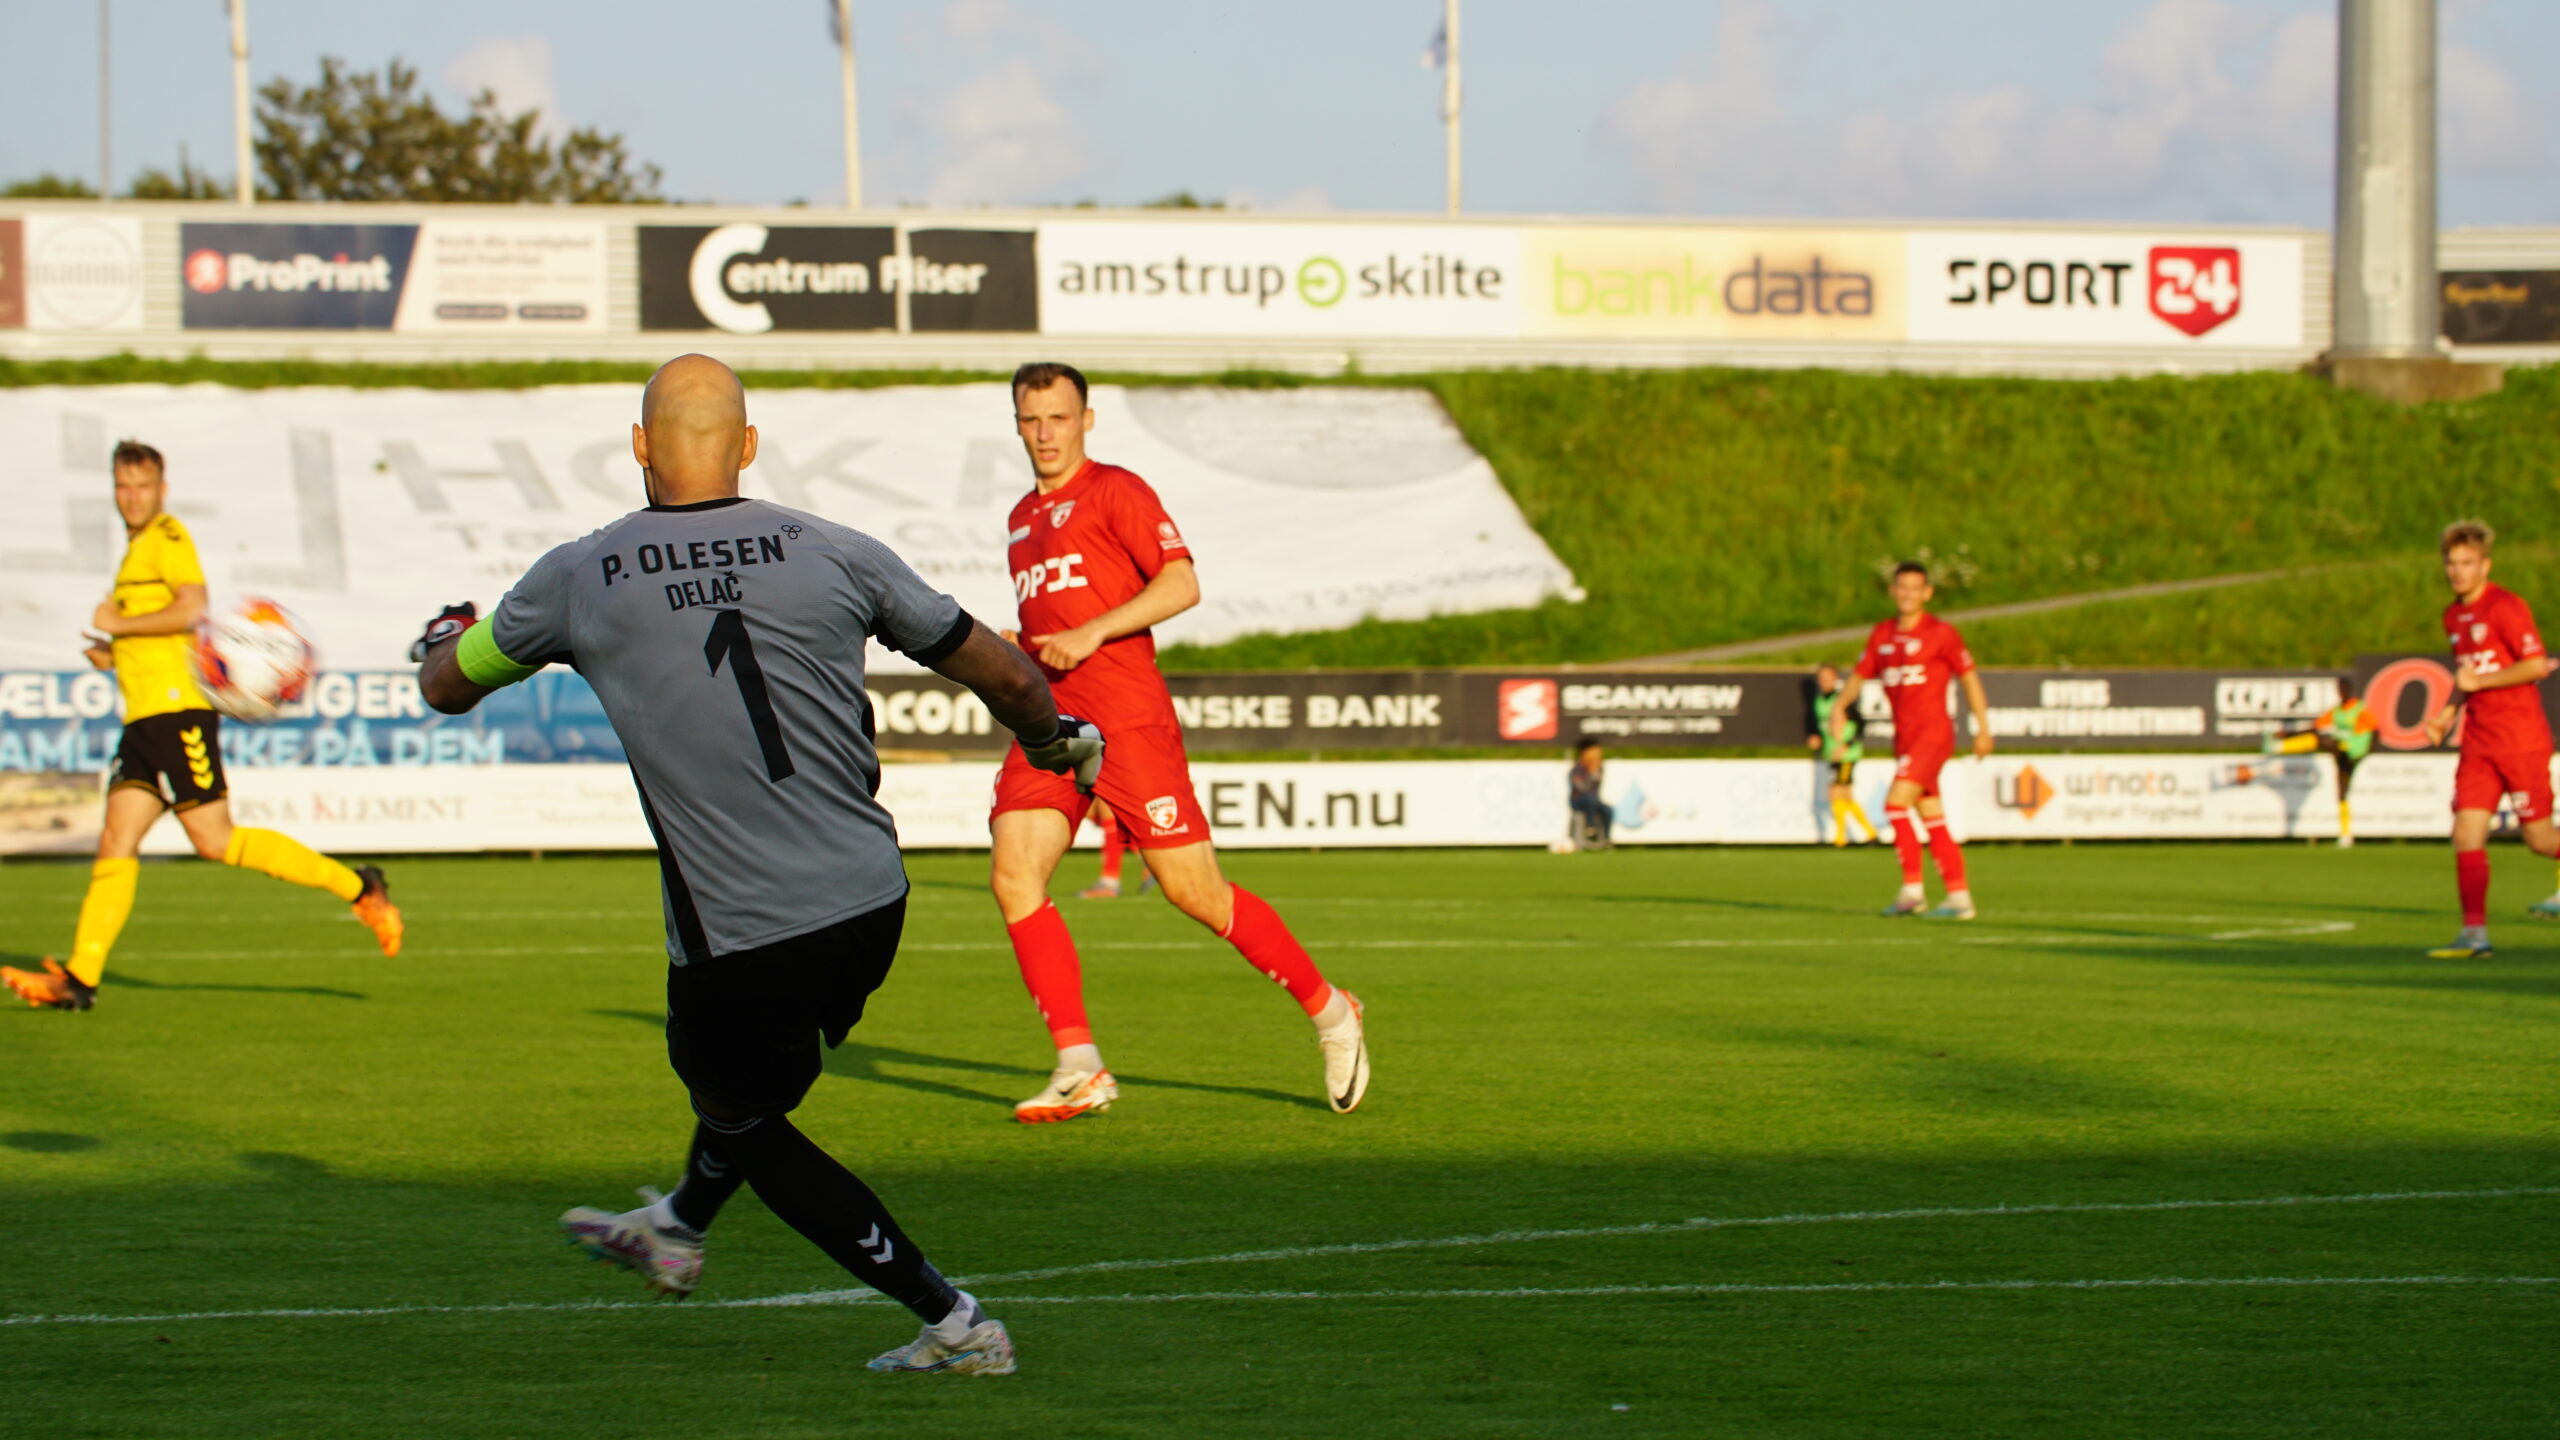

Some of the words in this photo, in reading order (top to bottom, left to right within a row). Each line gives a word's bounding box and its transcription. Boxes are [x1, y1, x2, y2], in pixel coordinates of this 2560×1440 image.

[228, 253, 393, 294] ProPrint
[690, 222, 870, 334] Centrum
[1059, 255, 1285, 308] amstrup
[1359, 253, 1503, 299] skilte
[1553, 253, 1875, 317] bankdata
[1948, 260, 2133, 305] SPORT
[2154, 256, 2238, 315] 24
[601, 553, 630, 588] P.
[637, 534, 786, 575] OLESEN
[664, 570, 743, 611] DELAČ
[703, 608, 796, 783] 1
[1306, 694, 1441, 728] BANK
[1561, 684, 1742, 710] SCANVIEW
[391, 727, 504, 766] DEM
[1210, 781, 1406, 828] EN.nu
